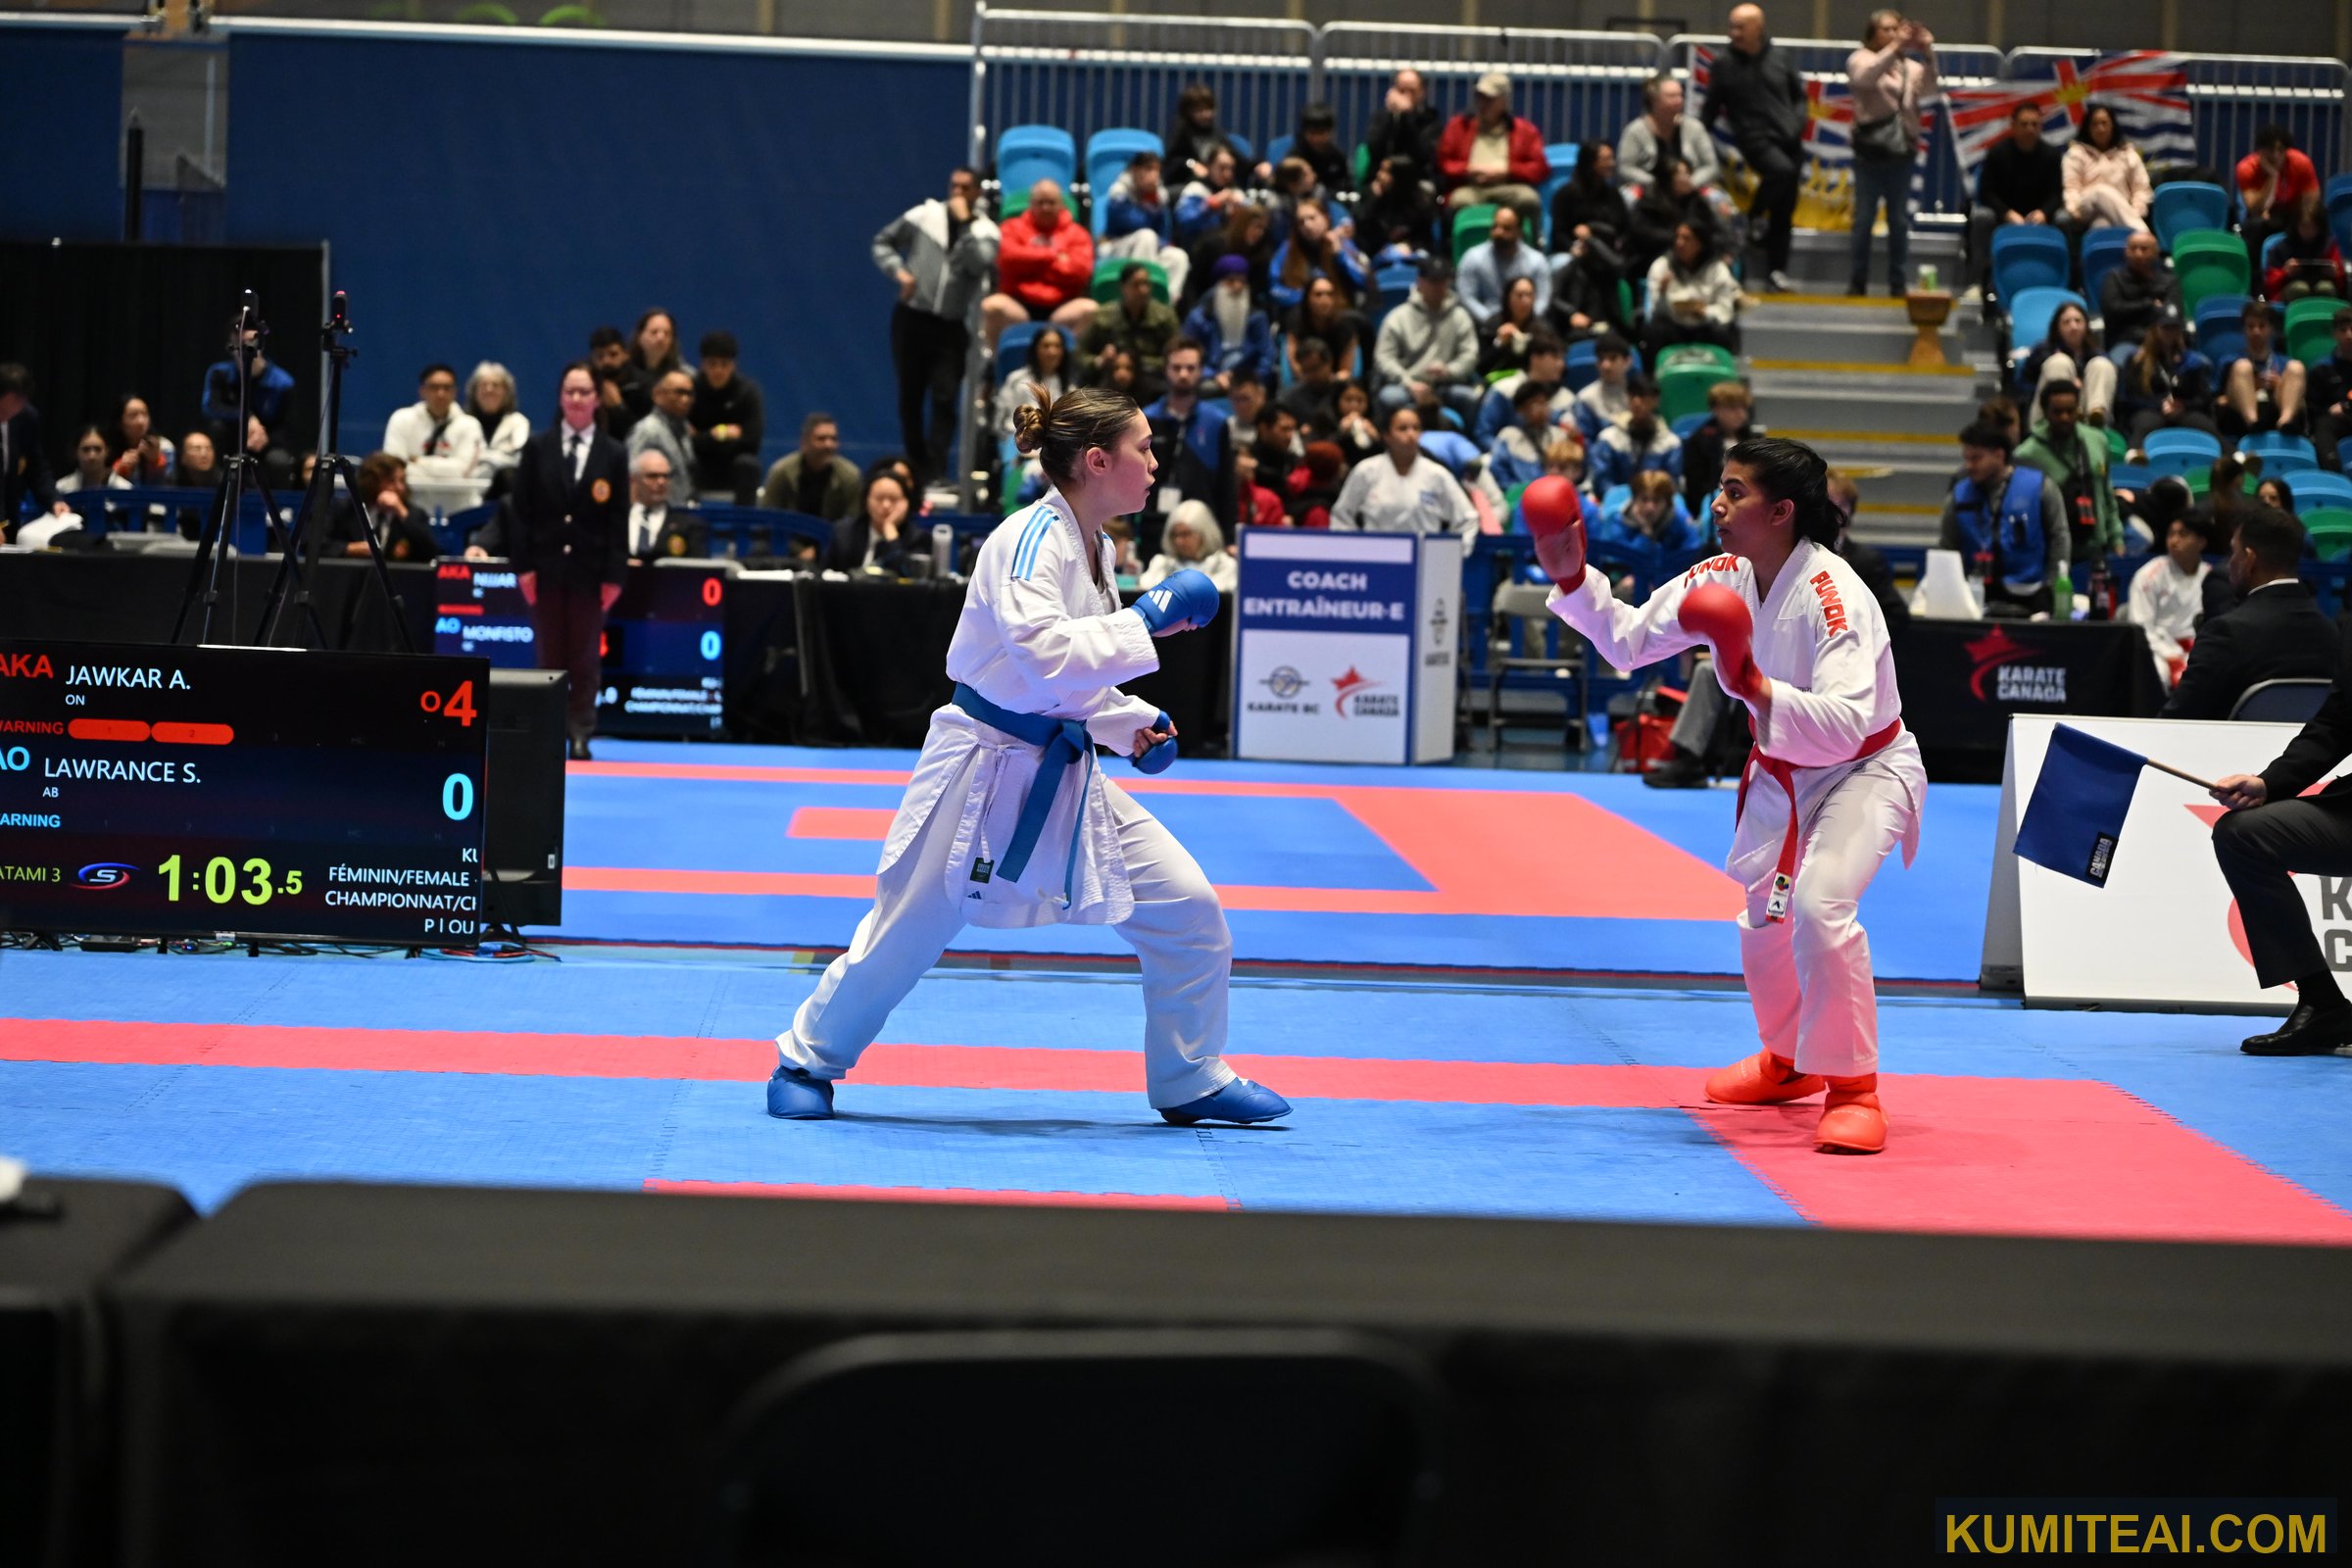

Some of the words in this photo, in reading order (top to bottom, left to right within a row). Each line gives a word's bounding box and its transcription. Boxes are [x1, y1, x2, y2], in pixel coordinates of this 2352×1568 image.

[1287, 570, 1368, 592] COACH
[1684, 555, 1740, 589] UNOK
[702, 578, 722, 607] 0
[1809, 569, 1848, 637] PUNOK
[435, 616, 461, 634] AO
[701, 630, 722, 661] 0
[66, 665, 163, 689] JAWKAR
[169, 669, 191, 690] A.
[1997, 665, 2066, 685] KARATE
[66, 694, 85, 706] ON
[1997, 684, 2066, 704] CANADA
[0, 720, 64, 735] ARNING
[45, 758, 175, 782] LAWRANCE
[182, 763, 201, 784] S.
[42, 787, 59, 798] AB
[442, 772, 474, 820] 0
[0, 812, 61, 828] ARNING
[51, 867, 61, 882] 3
[328, 863, 469, 887] FÉMININ/FEMALE
